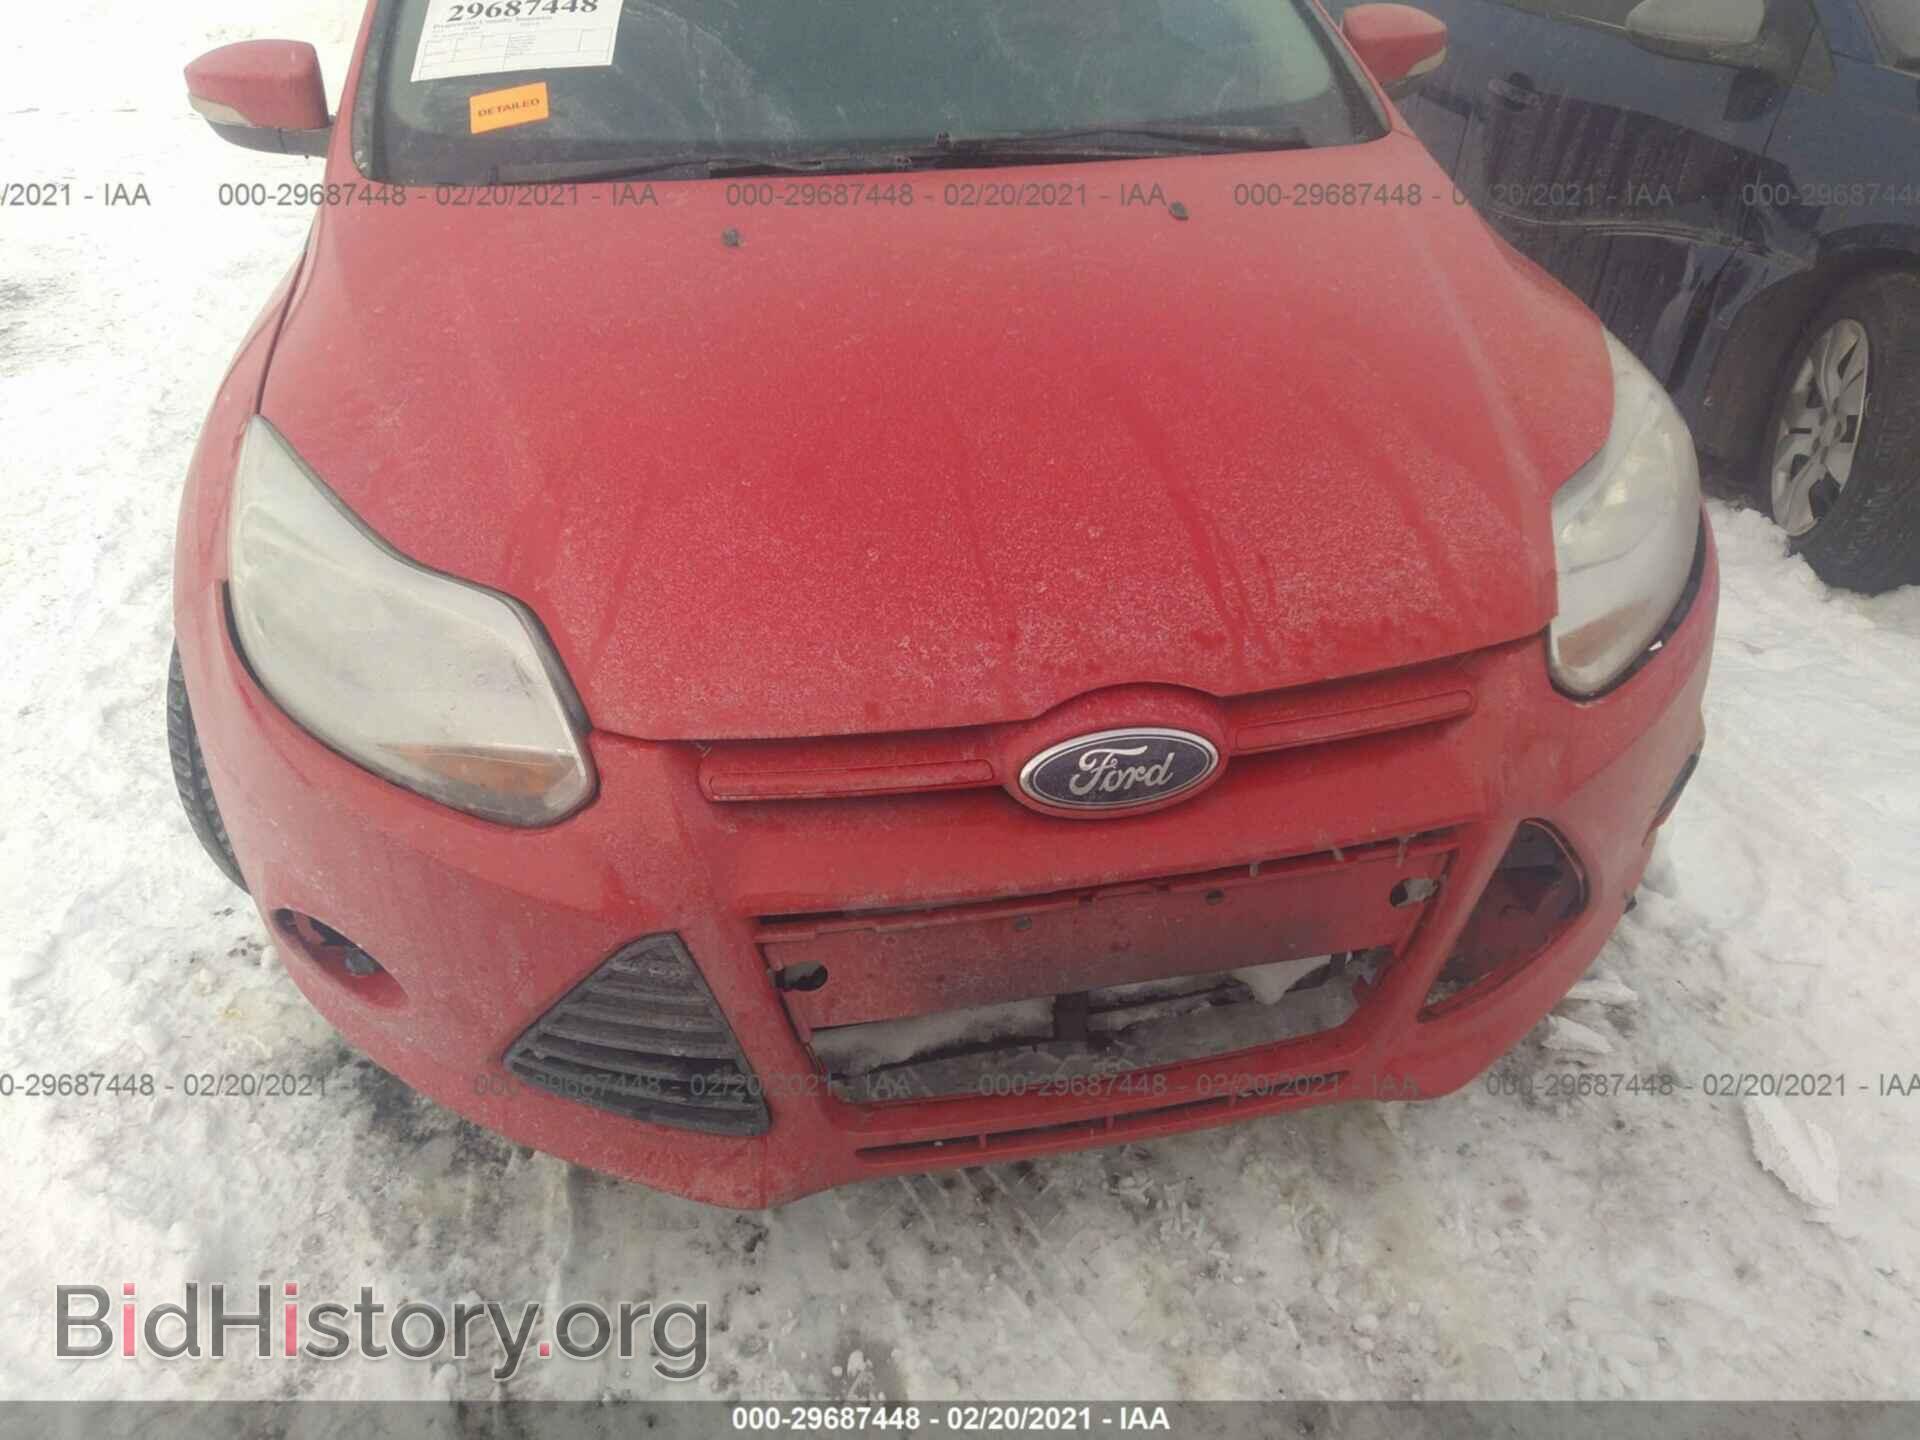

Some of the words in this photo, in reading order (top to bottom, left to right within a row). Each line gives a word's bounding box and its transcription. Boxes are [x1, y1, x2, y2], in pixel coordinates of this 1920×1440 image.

[447, 0, 598, 22] 29687448
[477, 97, 541, 118] DETAILED
[1069, 745, 1176, 796] Ford
